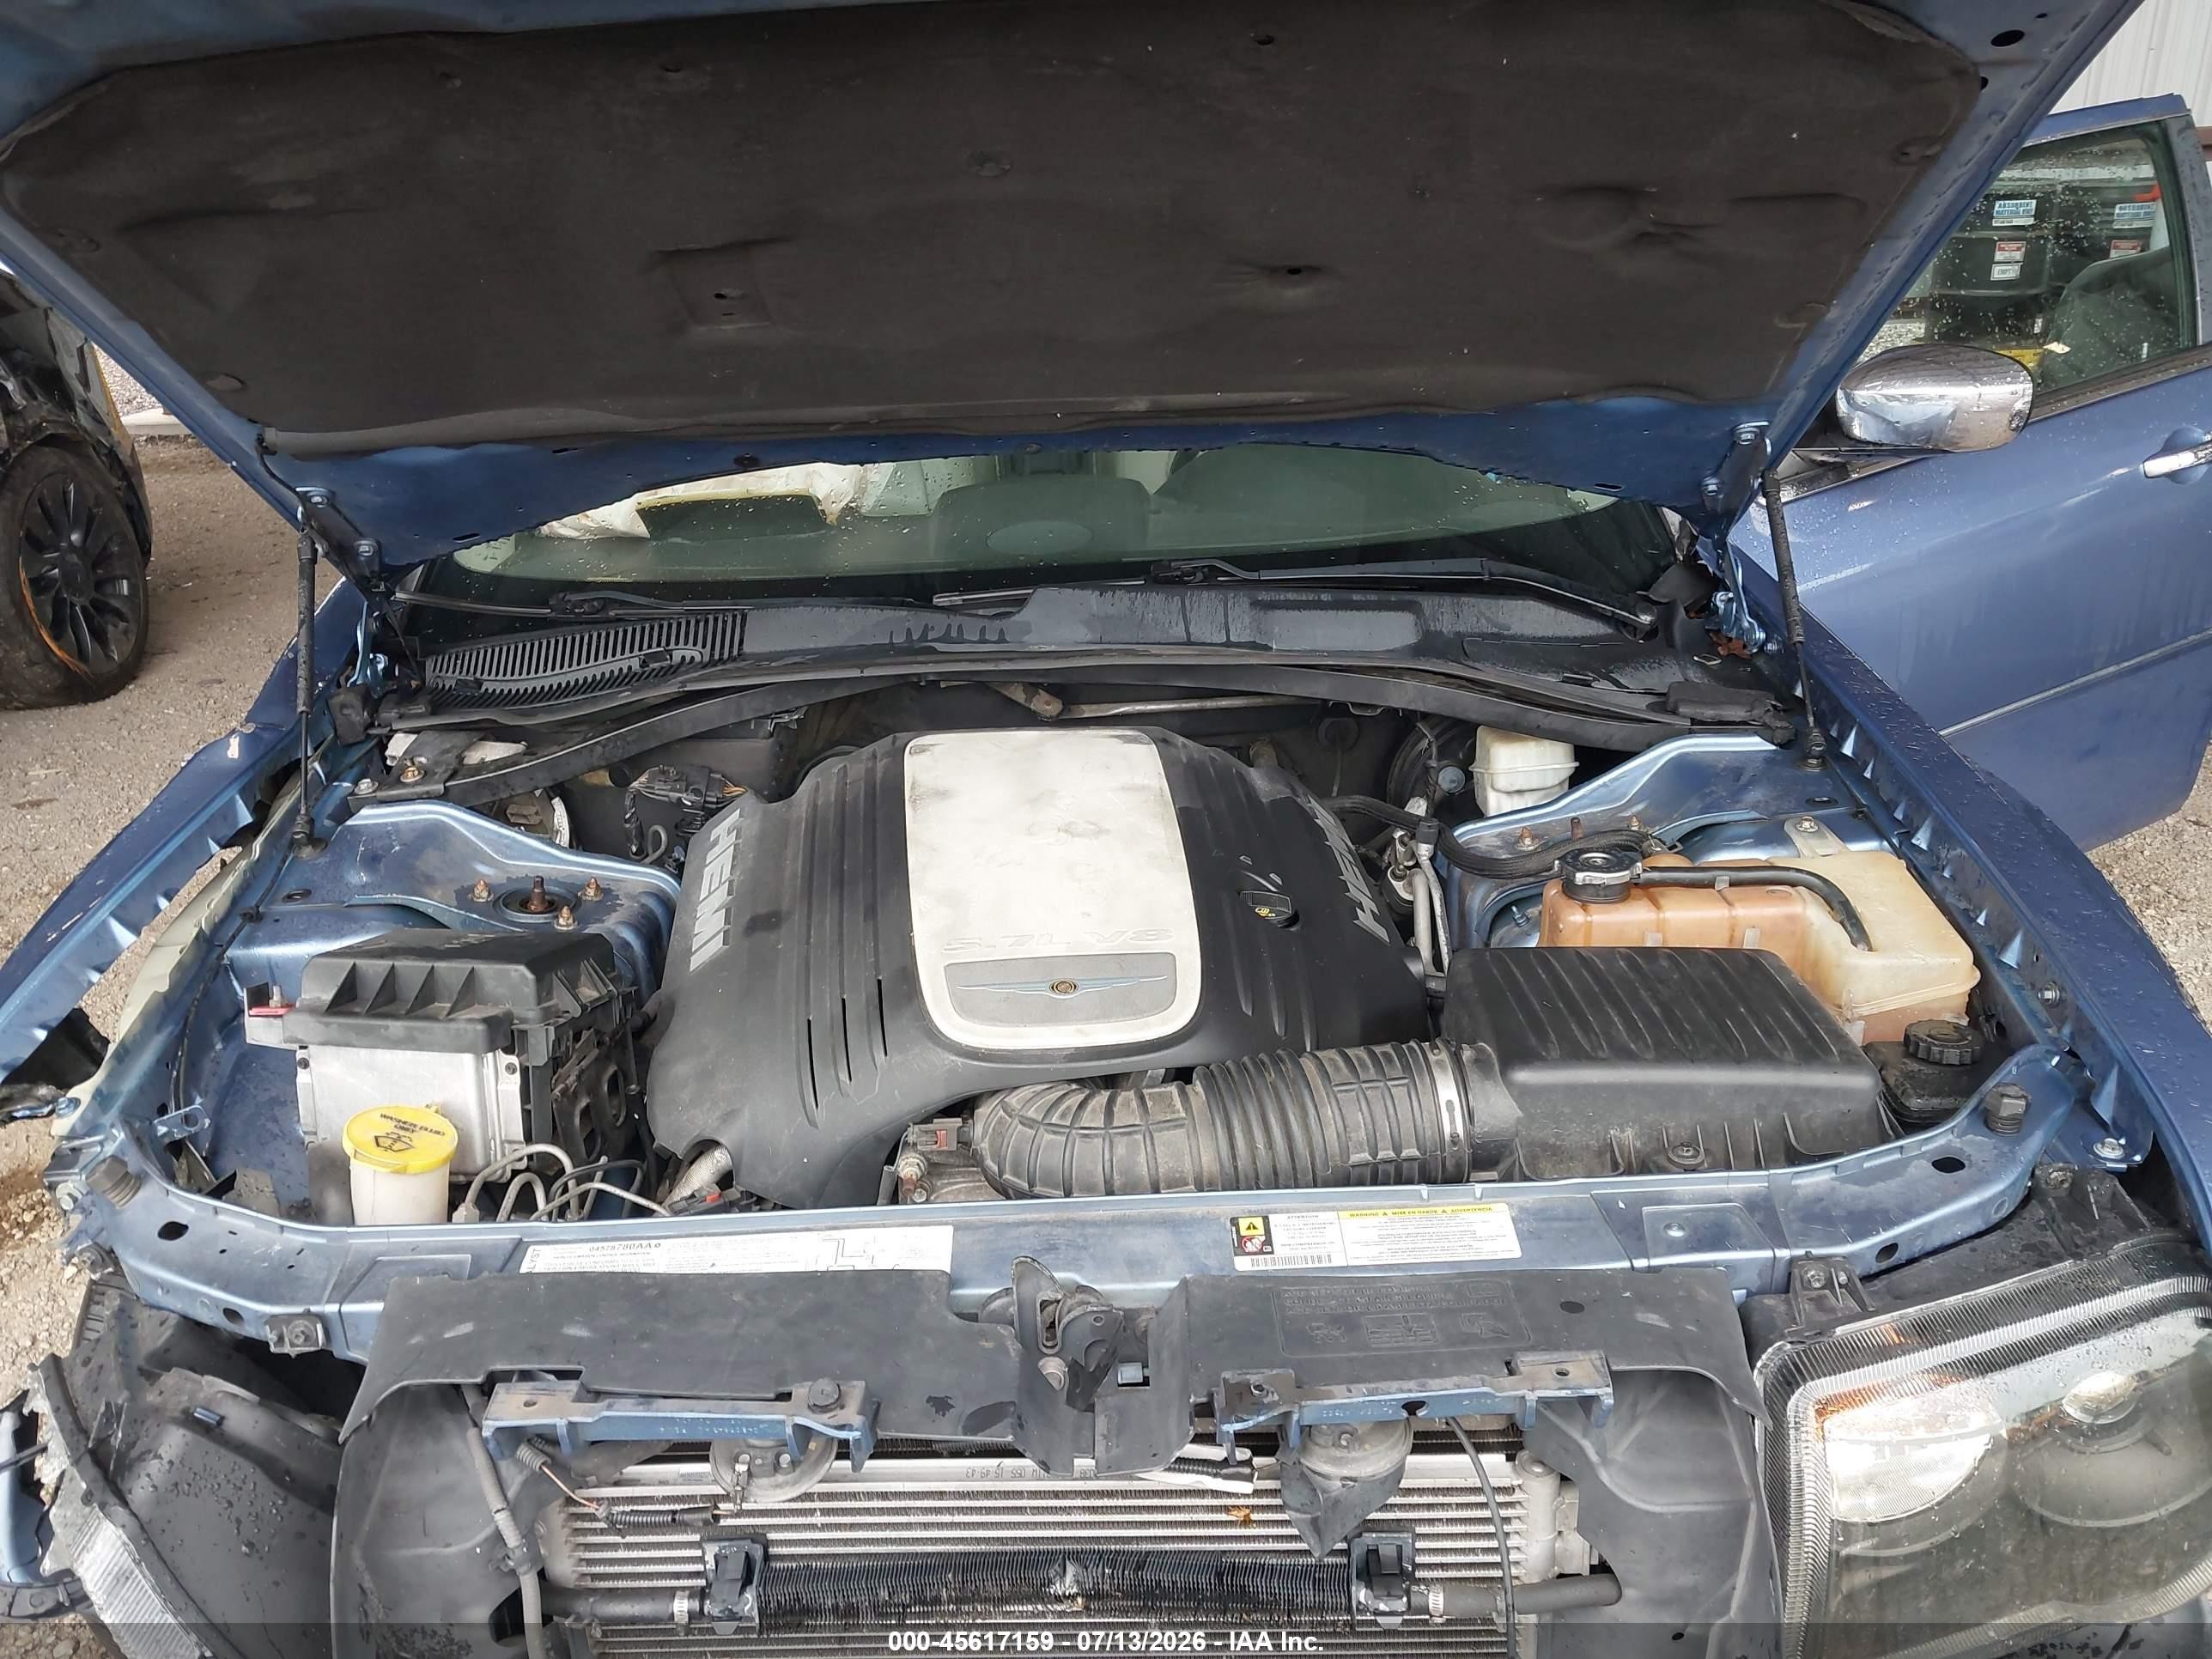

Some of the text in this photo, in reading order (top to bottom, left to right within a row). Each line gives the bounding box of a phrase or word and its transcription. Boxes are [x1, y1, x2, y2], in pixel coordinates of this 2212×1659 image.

[1308, 795, 1390, 943] HEMI
[690, 808, 741, 972] HEMI
[941, 927, 1175, 952] 5.7L V8
[380, 1114, 445, 1136] WASHER FLUID
[393, 1123, 416, 1133] ONLY
